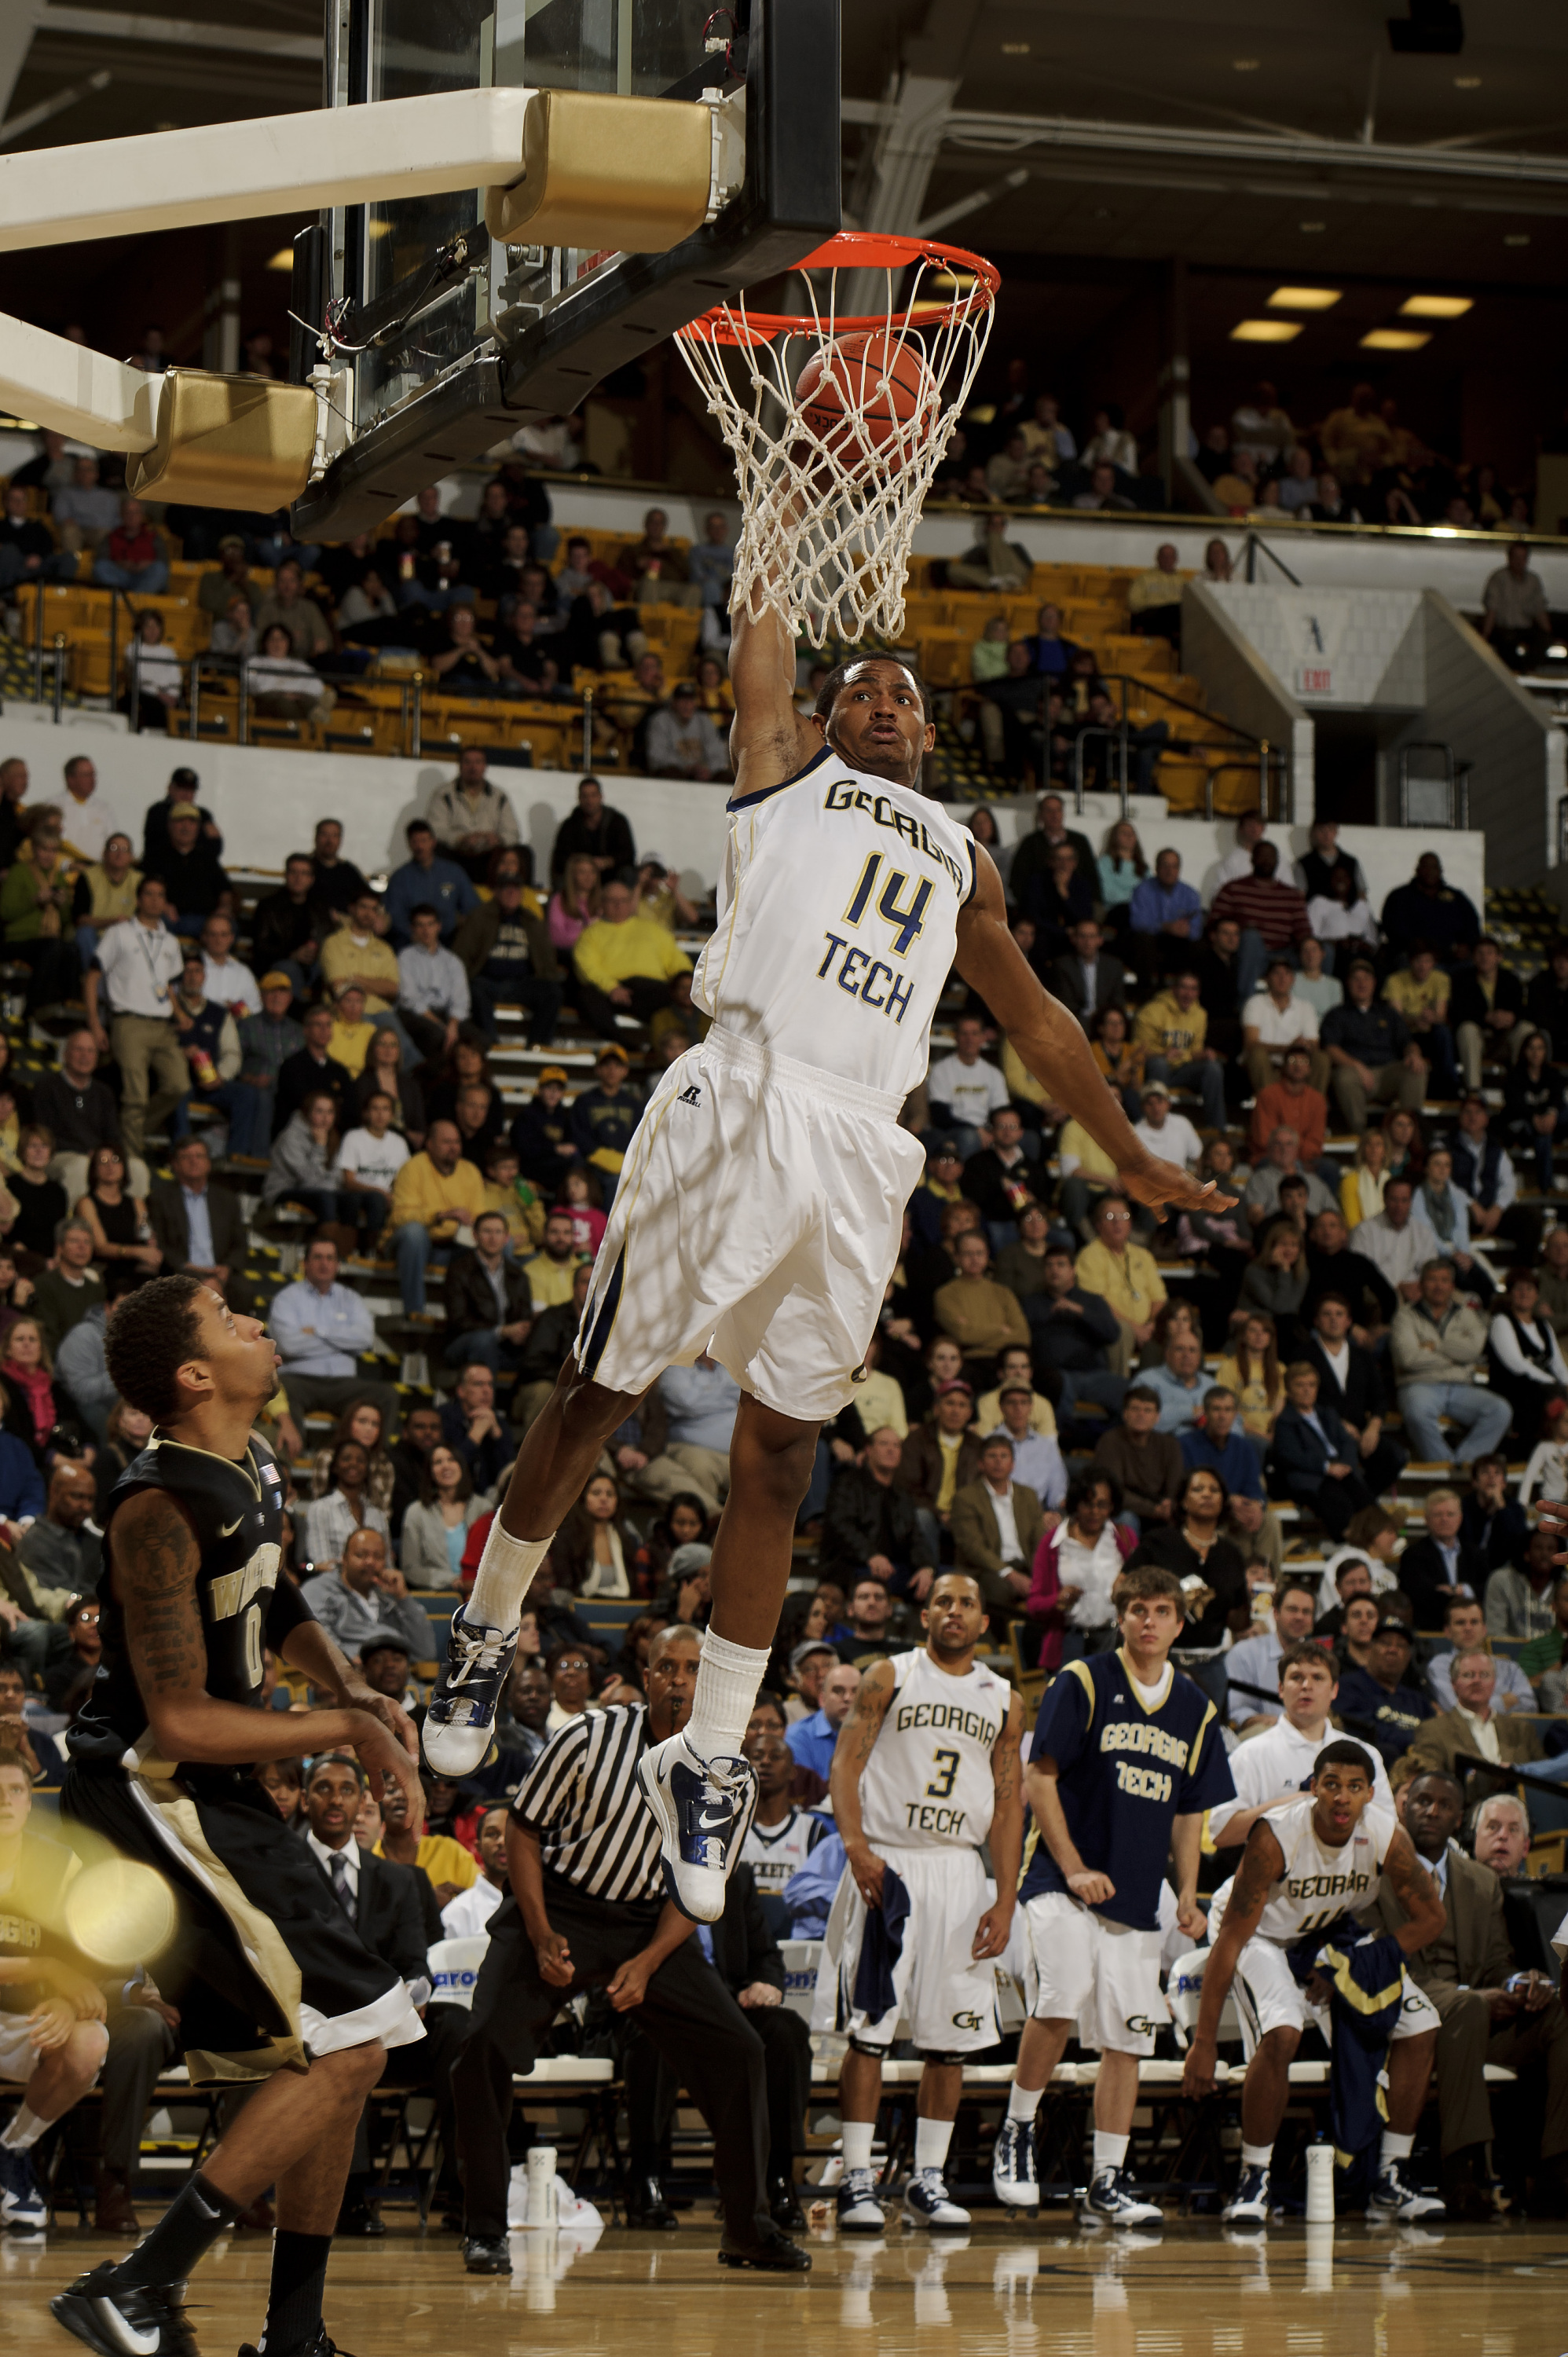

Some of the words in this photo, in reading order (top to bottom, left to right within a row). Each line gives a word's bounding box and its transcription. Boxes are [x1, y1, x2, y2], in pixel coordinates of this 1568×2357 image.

[841, 851, 936, 959] 14
[816, 930, 915, 1025] TECH
[676, 1095, 702, 1108] RUSSELL
[897, 1703, 996, 1750] GEORGIA
[1100, 1722, 1189, 1772] GEORGIA
[925, 1747, 960, 1799] 3
[1116, 1760, 1173, 1803] TECH
[906, 1803, 967, 1835] TECH
[0, 1914, 42, 1948] GIA
[432, 1970, 479, 1986] aro
[952, 2011, 984, 2031] GT
[1126, 2014, 1156, 2036] GT
